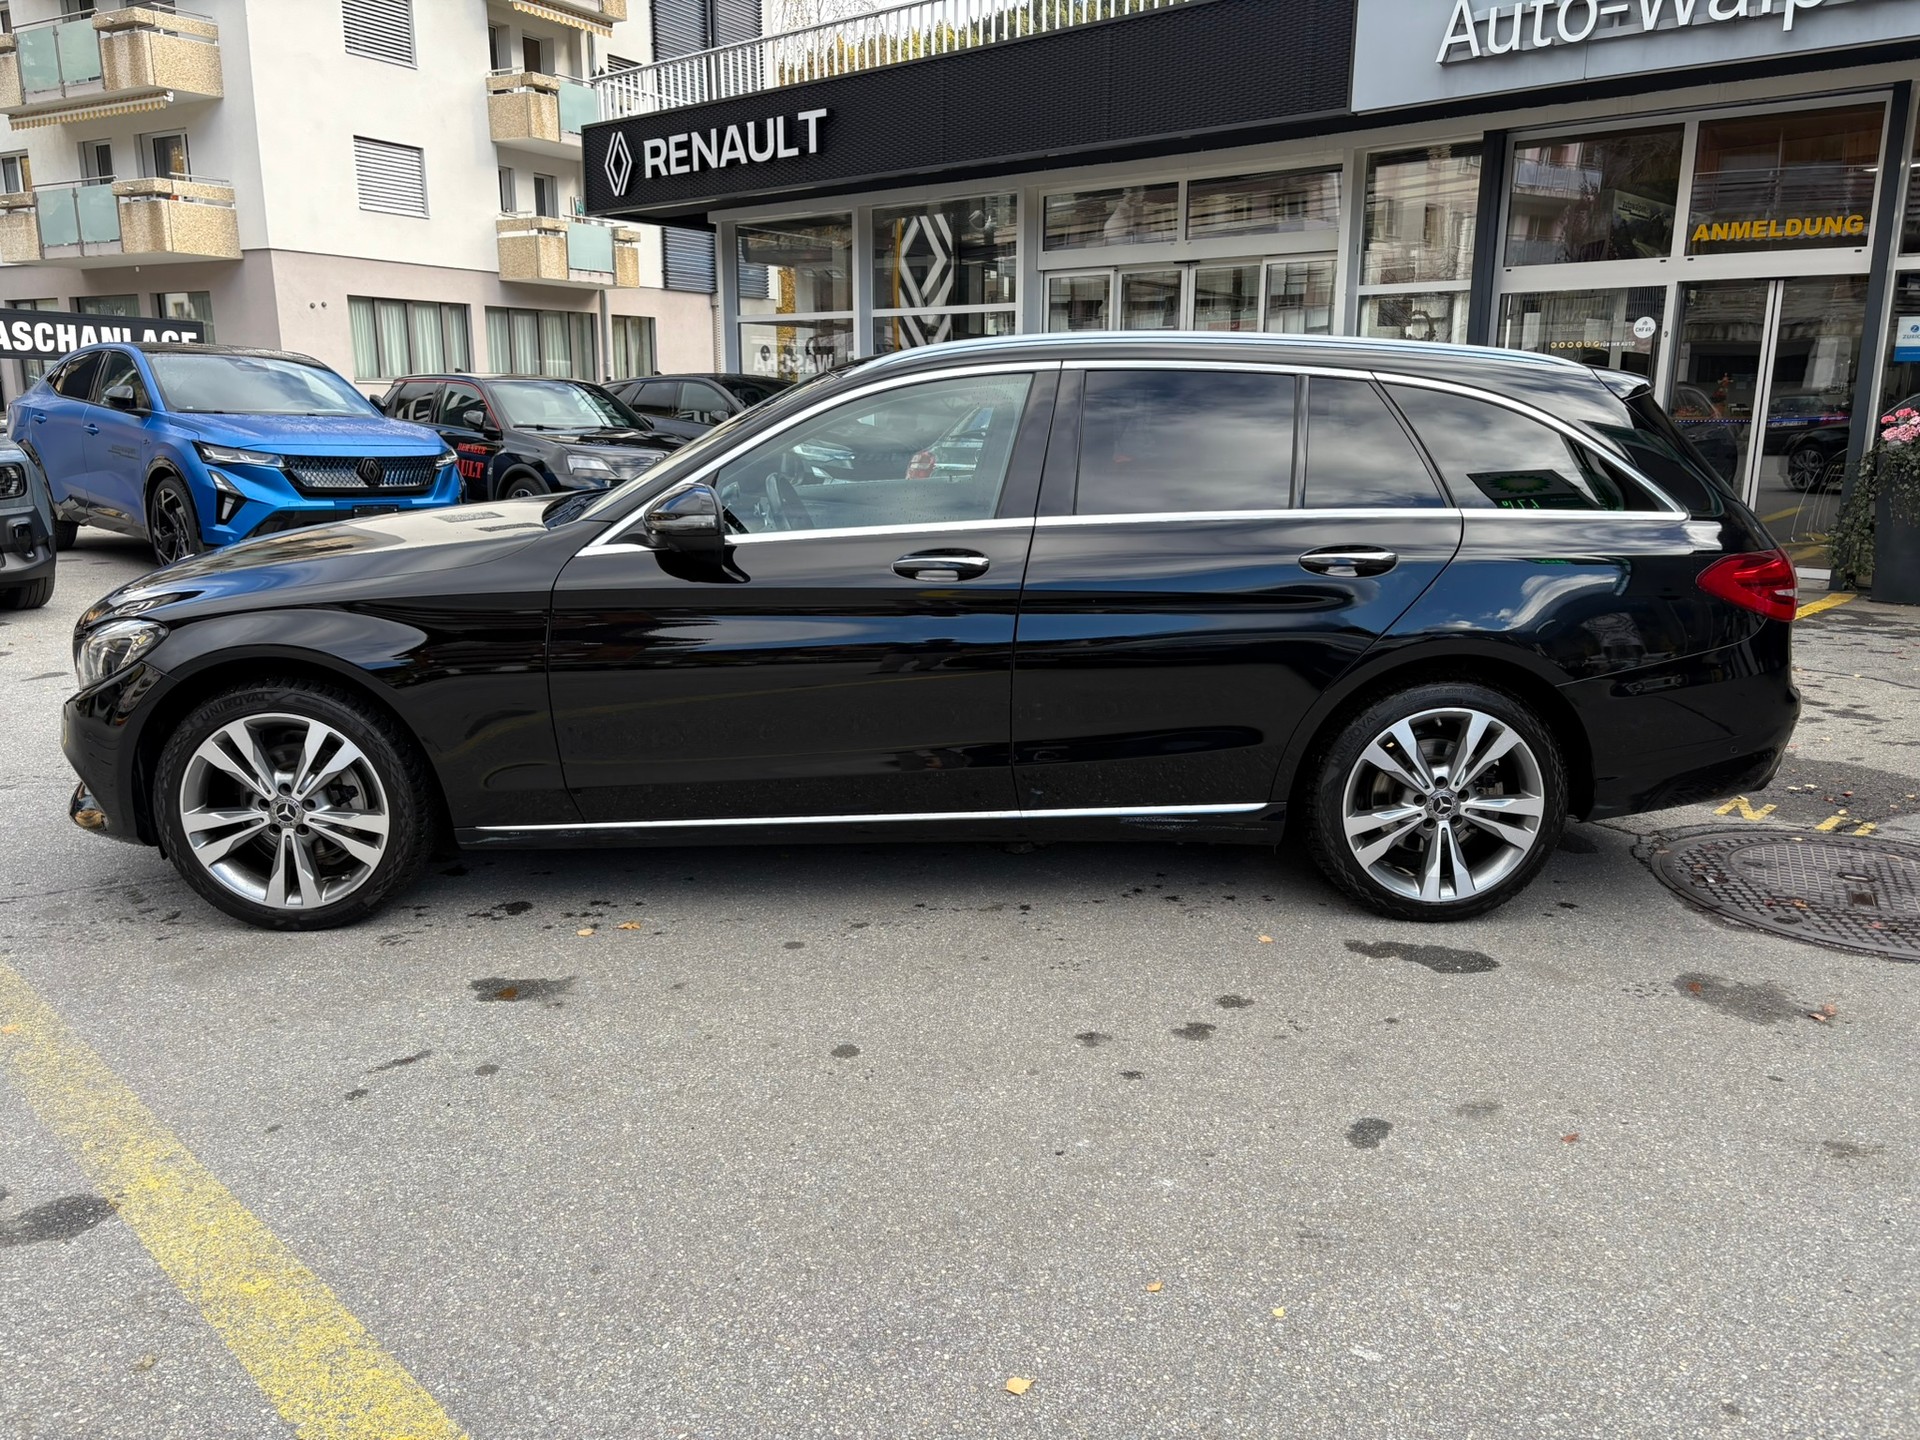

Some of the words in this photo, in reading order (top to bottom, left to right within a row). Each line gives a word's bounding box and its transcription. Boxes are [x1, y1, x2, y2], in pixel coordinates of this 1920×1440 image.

[1435, 0, 1826, 64] Auto-
[643, 108, 827, 179] RENAULT
[1691, 214, 1864, 242] ANMELDUNG
[198, 692, 271, 722] UNIROYAL
